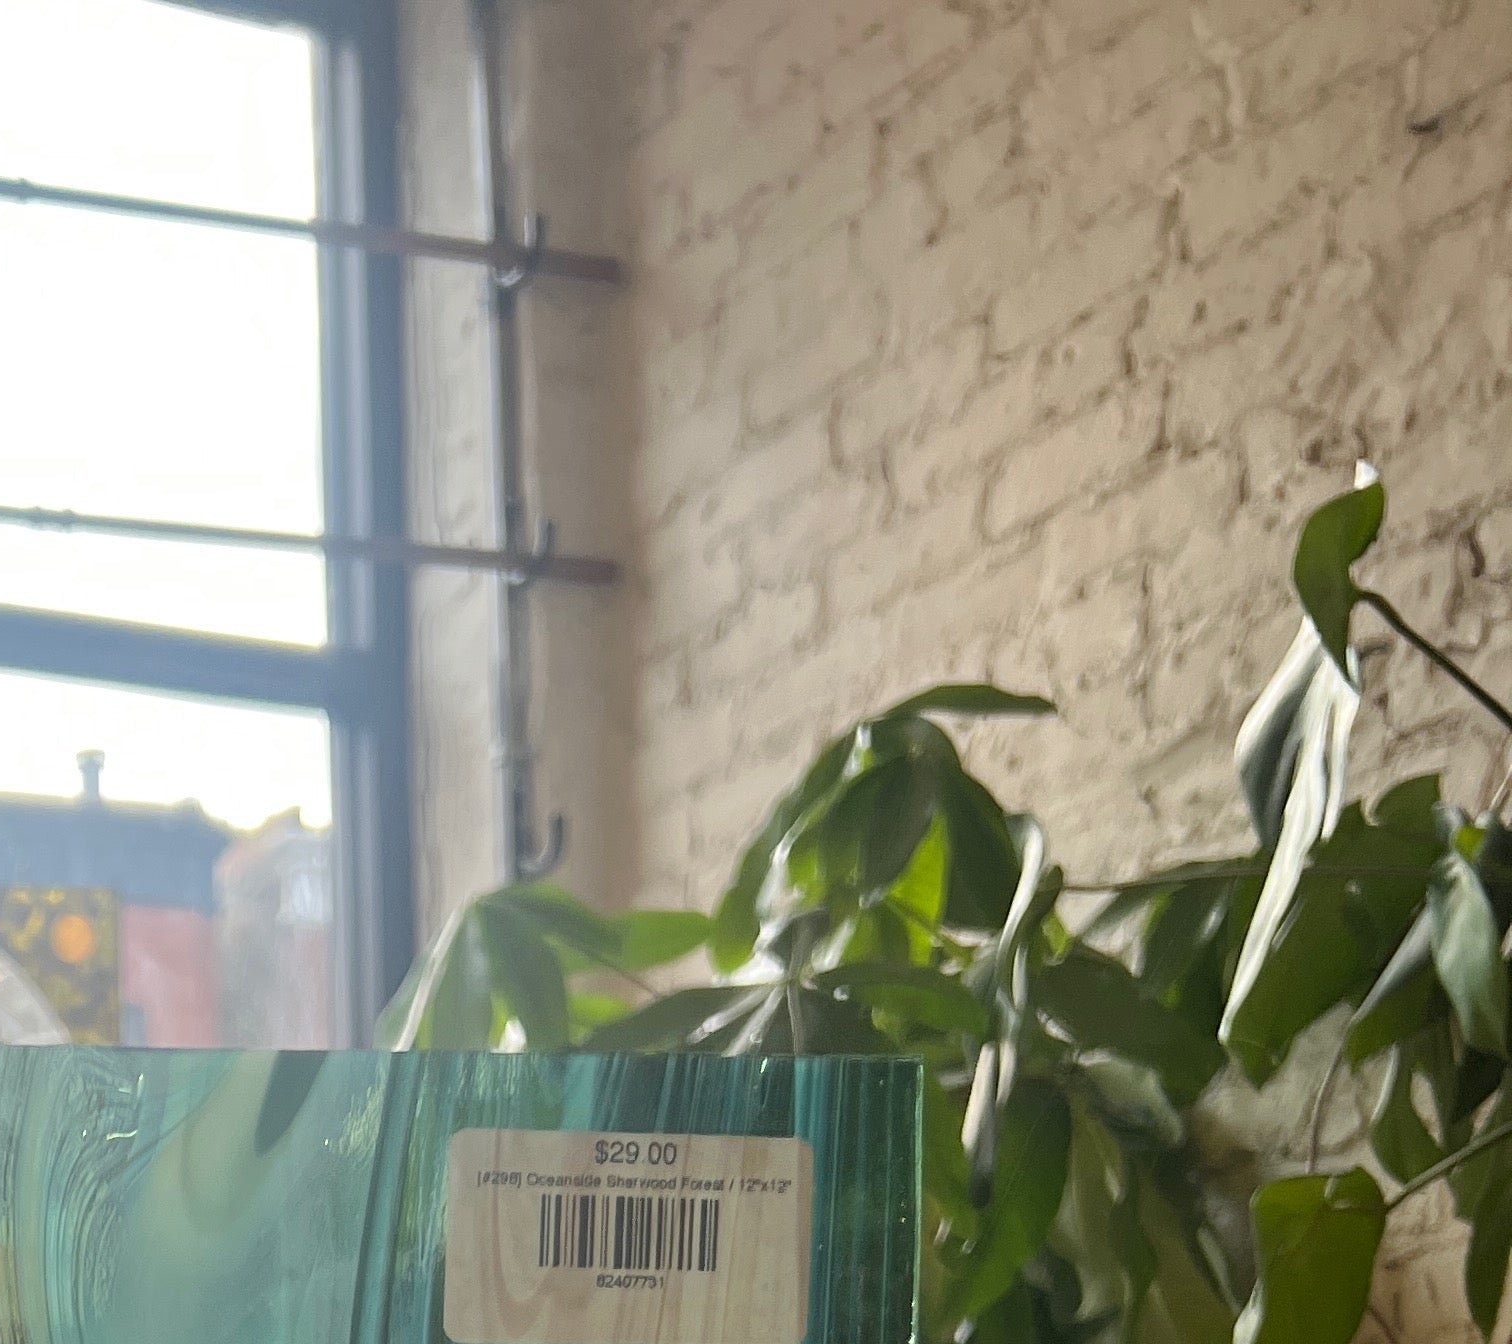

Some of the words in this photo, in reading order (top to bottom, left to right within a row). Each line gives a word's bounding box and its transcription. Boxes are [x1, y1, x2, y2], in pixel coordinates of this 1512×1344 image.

[594, 1140, 678, 1165] $29.00
[526, 1171, 602, 1189] Oceanside
[606, 1173, 677, 1190] Sherwood
[680, 1175, 725, 1191] Forest
[596, 1273, 665, 1290] 82407731
